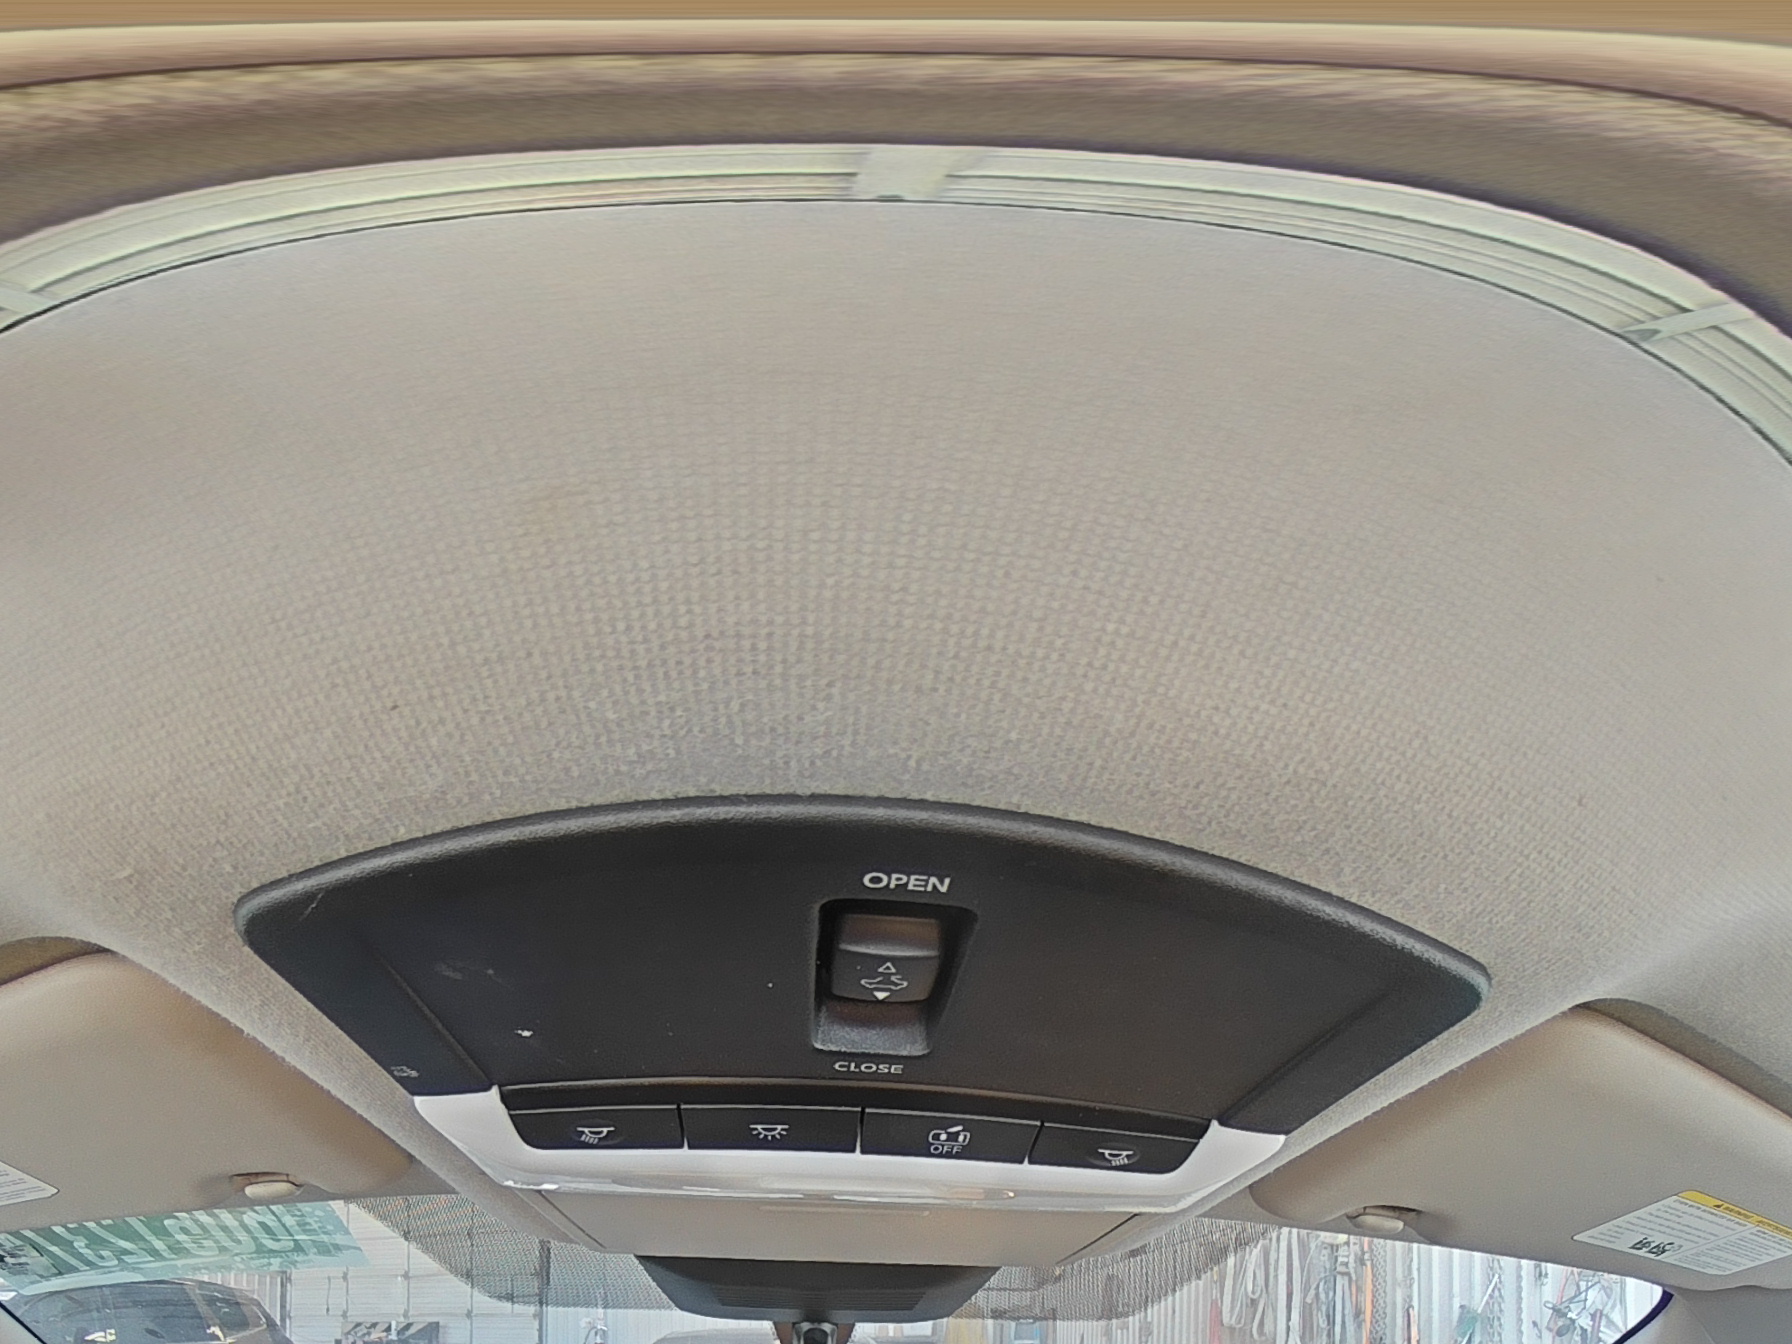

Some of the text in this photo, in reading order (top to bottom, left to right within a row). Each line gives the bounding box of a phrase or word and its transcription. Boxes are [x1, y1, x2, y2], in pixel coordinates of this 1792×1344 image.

[862, 871, 952, 894] OPEN
[832, 1061, 905, 1075] CLOSE
[930, 1144, 963, 1155] OFF
